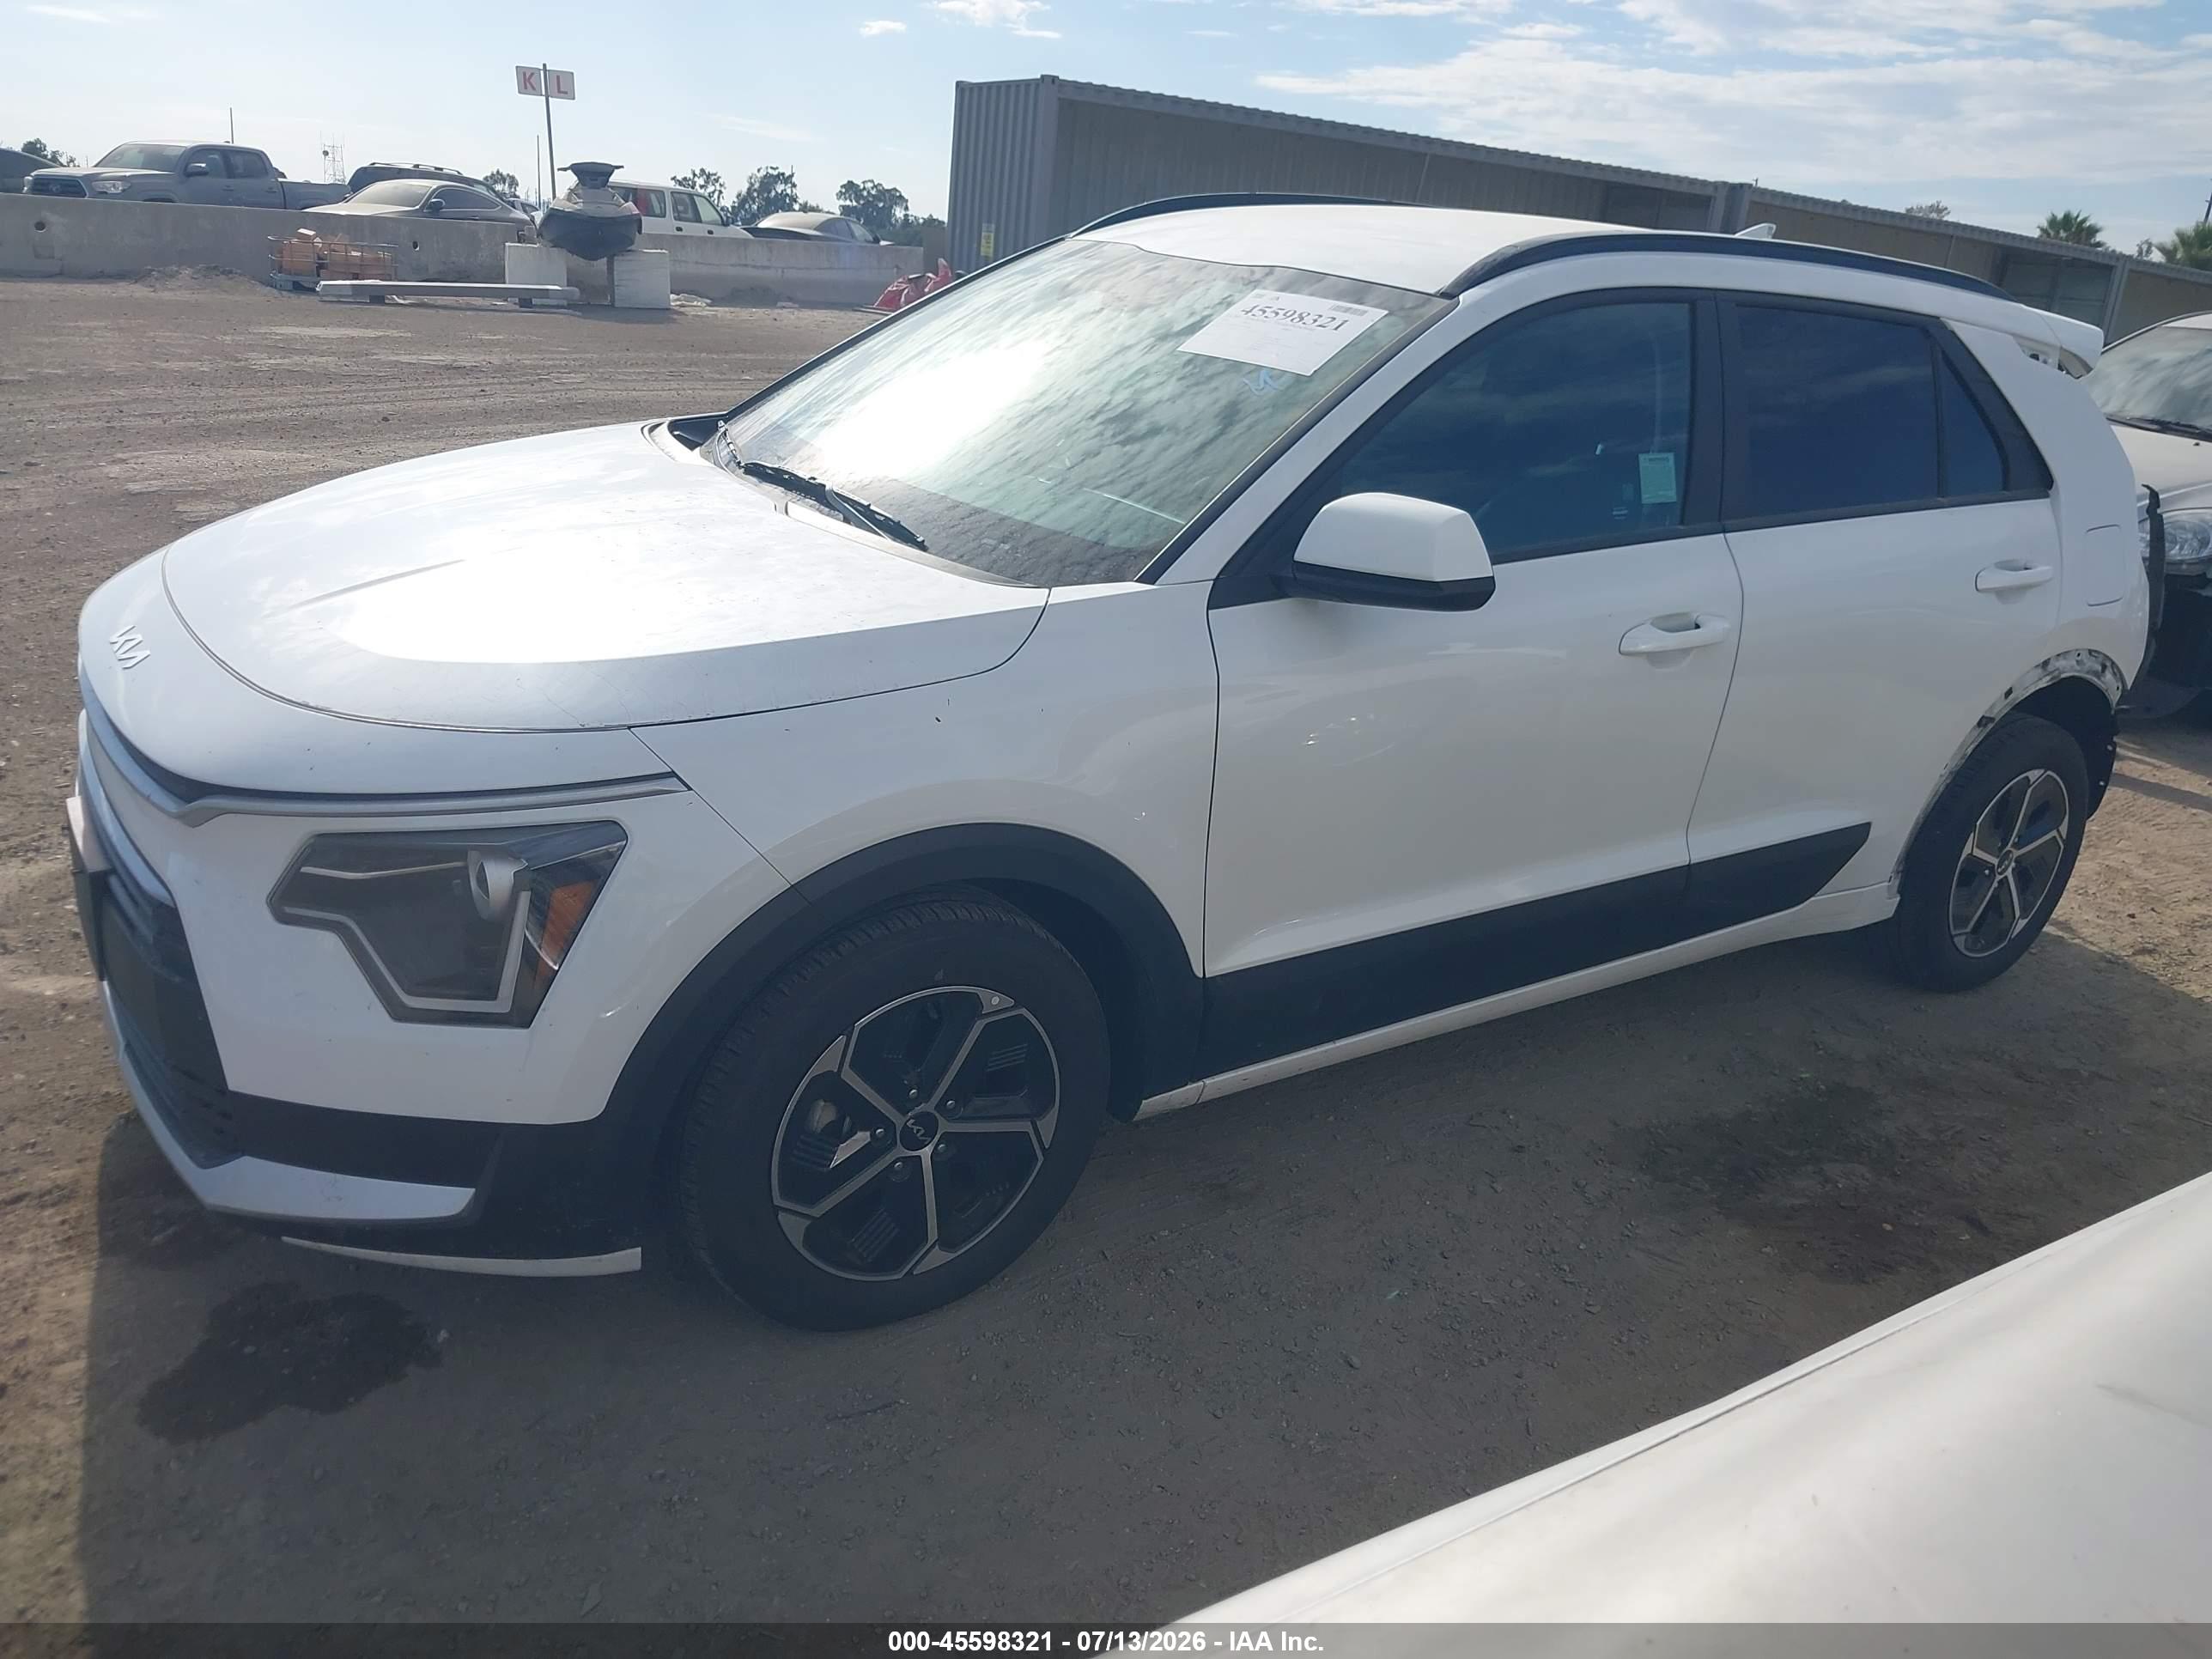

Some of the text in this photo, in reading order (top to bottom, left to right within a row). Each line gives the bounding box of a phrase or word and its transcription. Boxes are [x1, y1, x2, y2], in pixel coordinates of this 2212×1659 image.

[522, 71, 537, 91] K
[556, 75, 568, 94] L
[1241, 304, 1349, 331] 45598321
